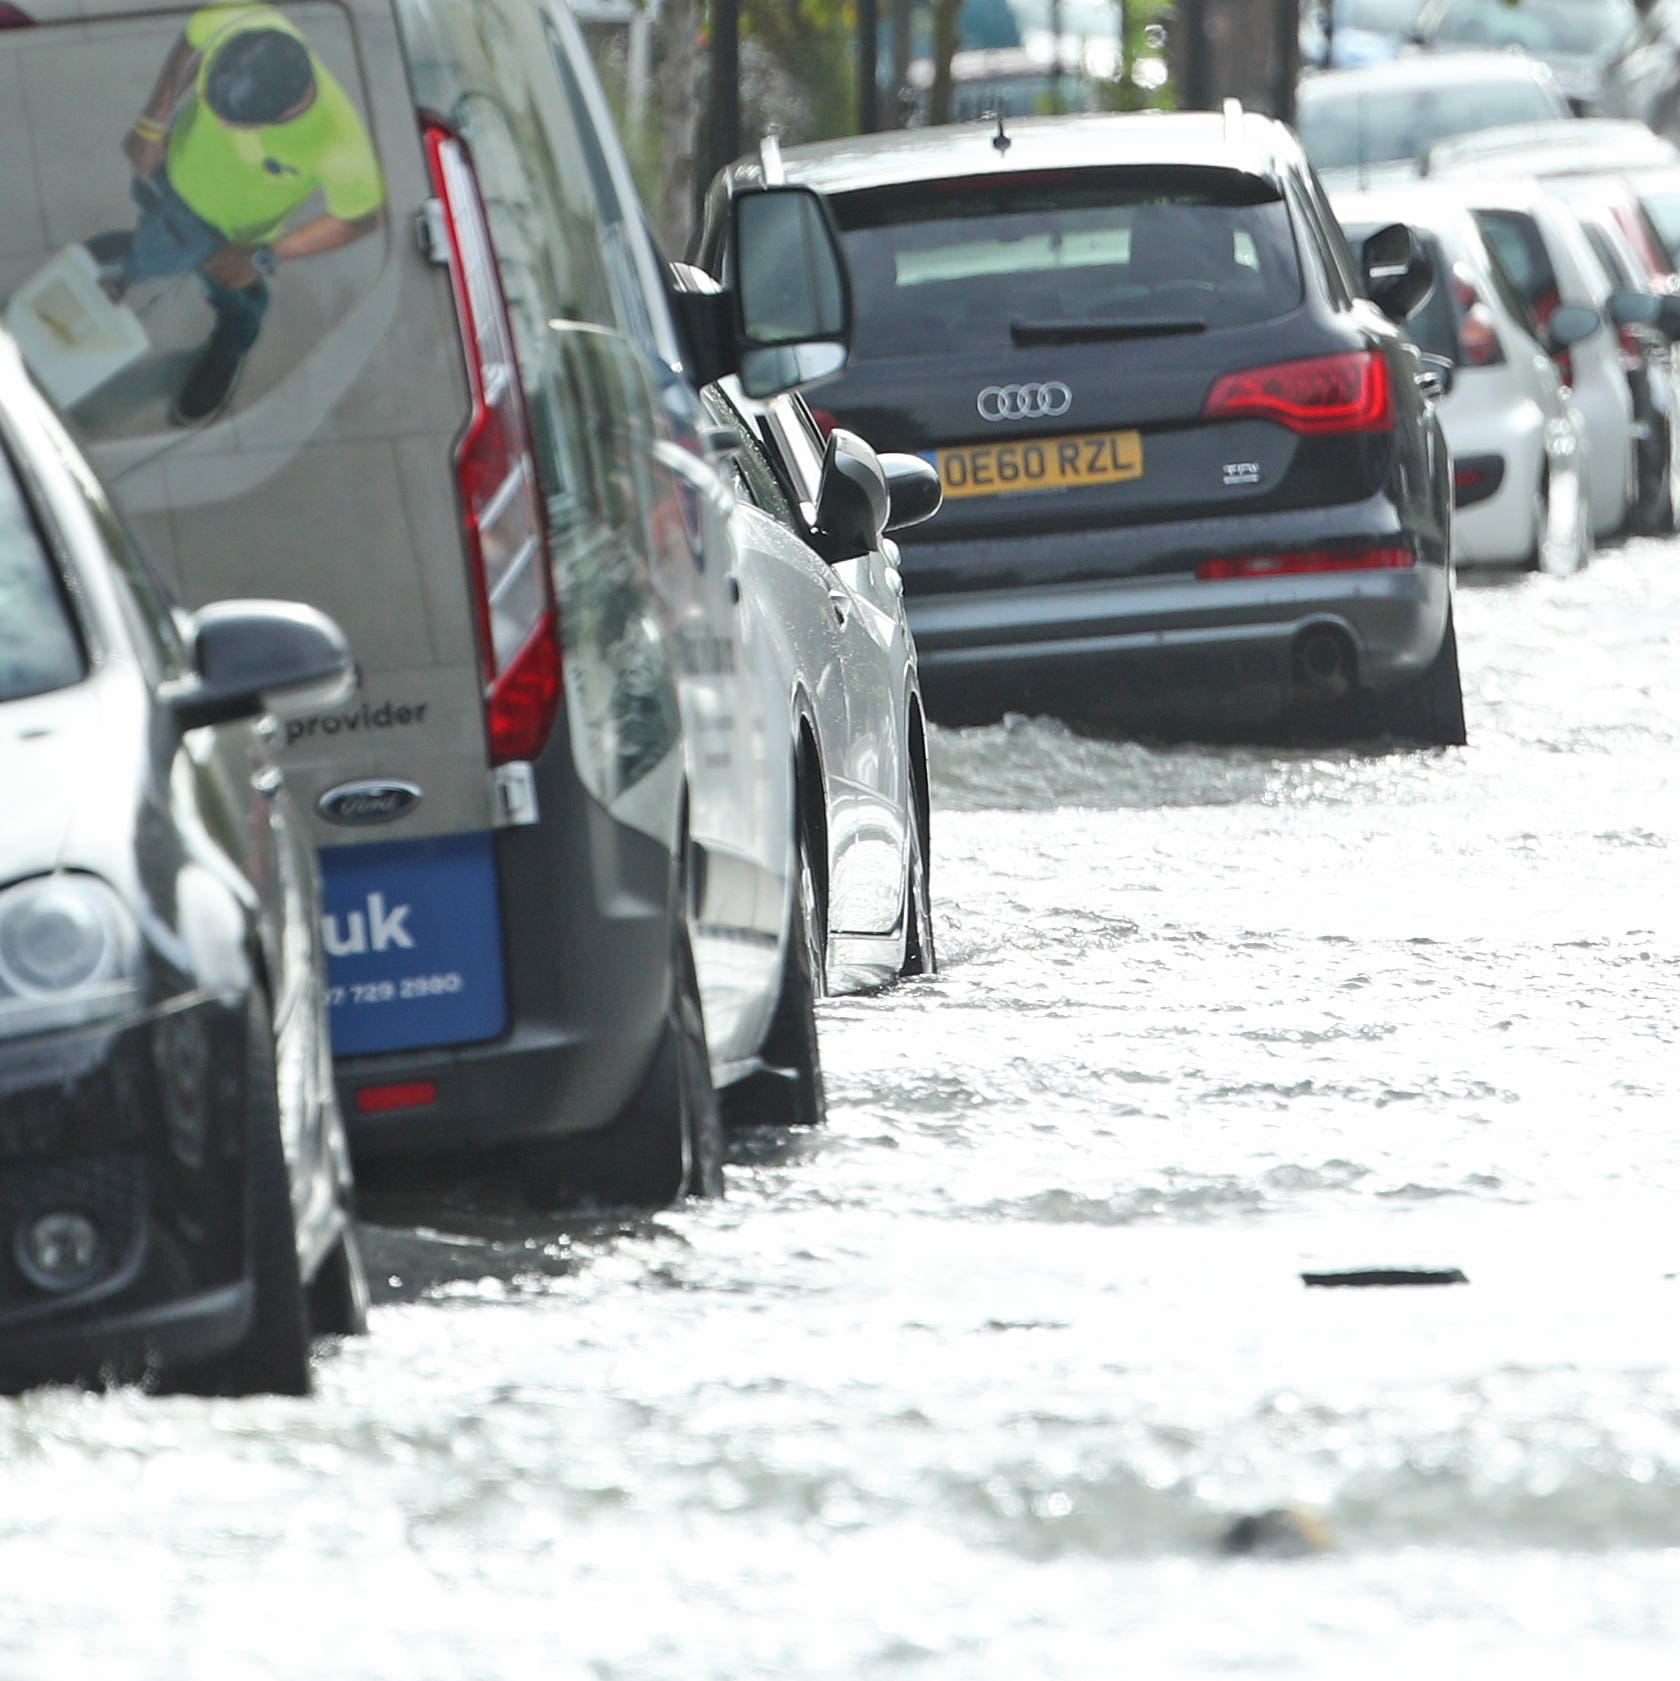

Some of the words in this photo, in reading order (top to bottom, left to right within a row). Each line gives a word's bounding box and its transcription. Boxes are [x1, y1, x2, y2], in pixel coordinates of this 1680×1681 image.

[943, 443, 1046, 487] OE60
[1058, 438, 1134, 478] RZL
[285, 699, 428, 745] provider
[350, 980, 395, 1004] 729
[399, 971, 463, 1000] 2980
